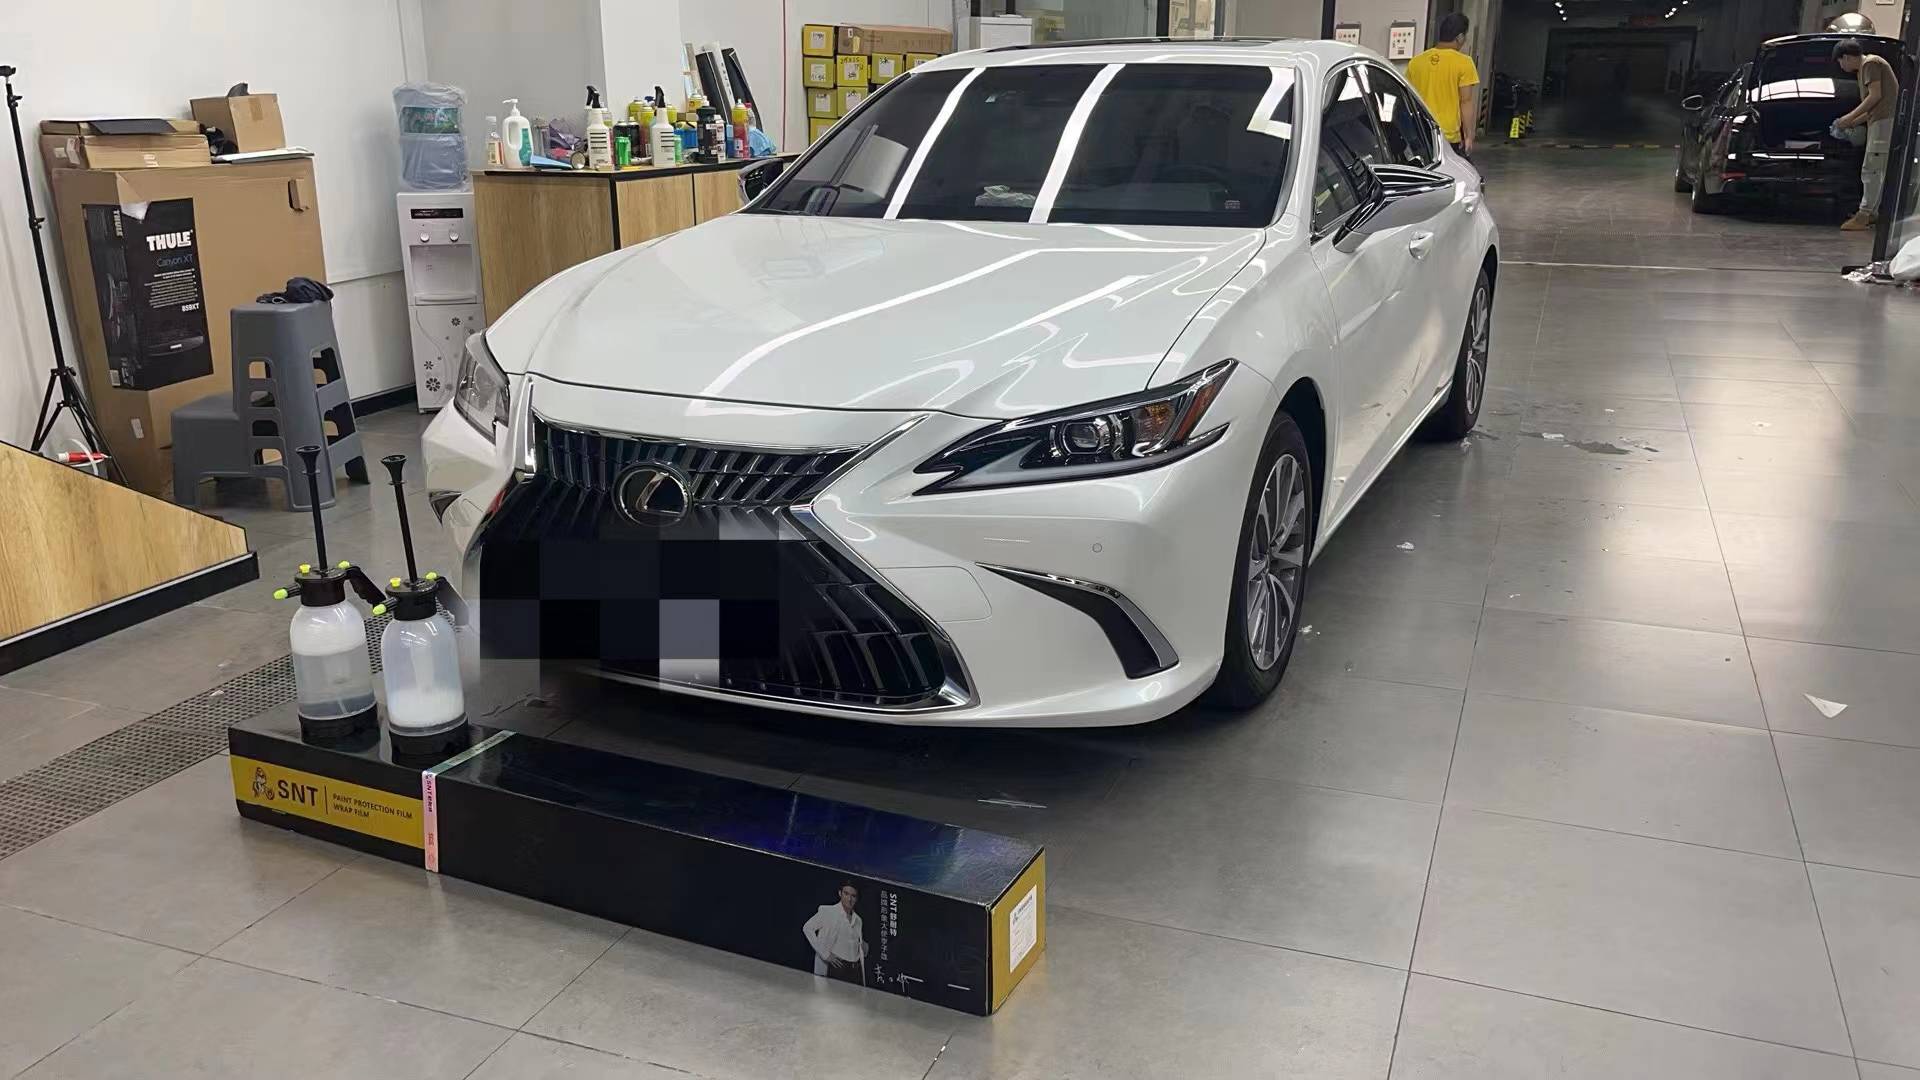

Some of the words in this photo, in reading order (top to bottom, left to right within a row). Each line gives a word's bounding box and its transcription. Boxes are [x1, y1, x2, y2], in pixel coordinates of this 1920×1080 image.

[147, 231, 192, 251] THULE
[156, 256, 182, 267] Canyon
[183, 254, 193, 264] XT
[277, 779, 319, 807] SNT
[333, 793, 353, 804] PAINT
[354, 798, 395, 815] PROTECTION
[396, 808, 413, 819] FILM
[333, 804, 353, 815] WRAP
[354, 809, 371, 818] FILM
